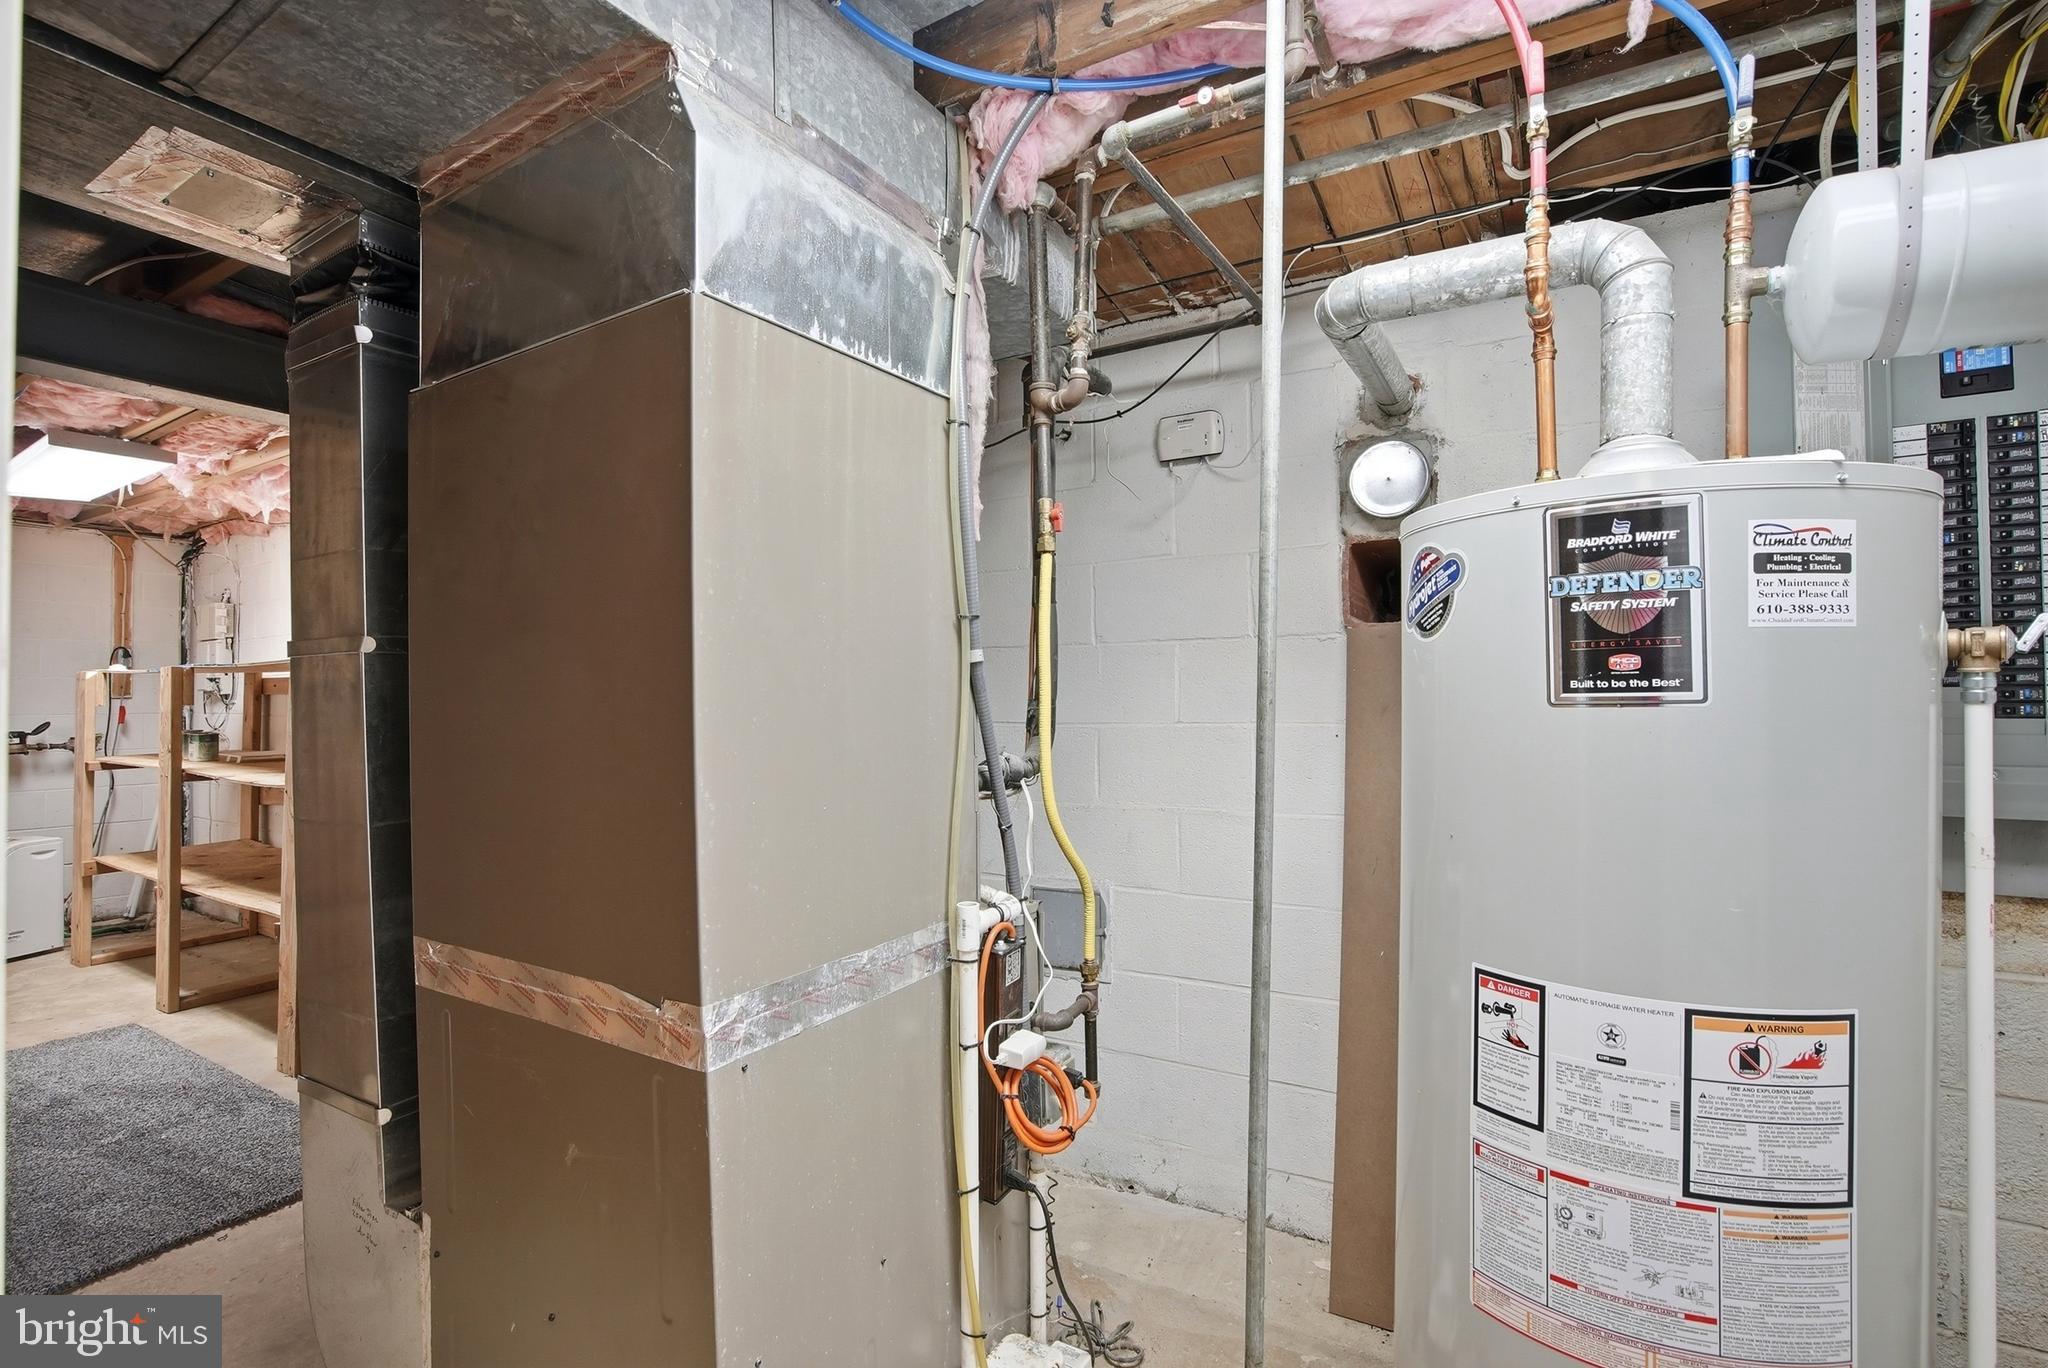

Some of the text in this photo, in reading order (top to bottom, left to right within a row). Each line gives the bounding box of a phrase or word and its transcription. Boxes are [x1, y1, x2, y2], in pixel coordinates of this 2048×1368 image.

[1567, 530, 1678, 549] BRADFORD WHITE
[1753, 532, 1853, 547] Climate Control
[1575, 541, 1669, 554] CORPORATION
[1773, 554, 1836, 562] Heating Cooling
[1766, 563, 1802, 571] Plumbing
[1550, 565, 1704, 598] DEFENDER
[1756, 579, 1850, 587] For Maintenance &
[1758, 590, 1848, 598] Service Please Call
[1570, 598, 1677, 612] SAFETY SYSTEM
[1757, 604, 1850, 614] 610-388-9333
[1570, 640, 1625, 649] ENERGY
[1570, 678, 1681, 688] Built to be the Best
[1497, 983, 1531, 999] DANGER
[1554, 993, 1674, 1017] AUTOMATIC STORAGE WATER HEATER
[1507, 1021, 1519, 1029] HOT
[1757, 1025, 1804, 1034] WARNING
[1593, 1184, 1627, 1197] OPERATING
